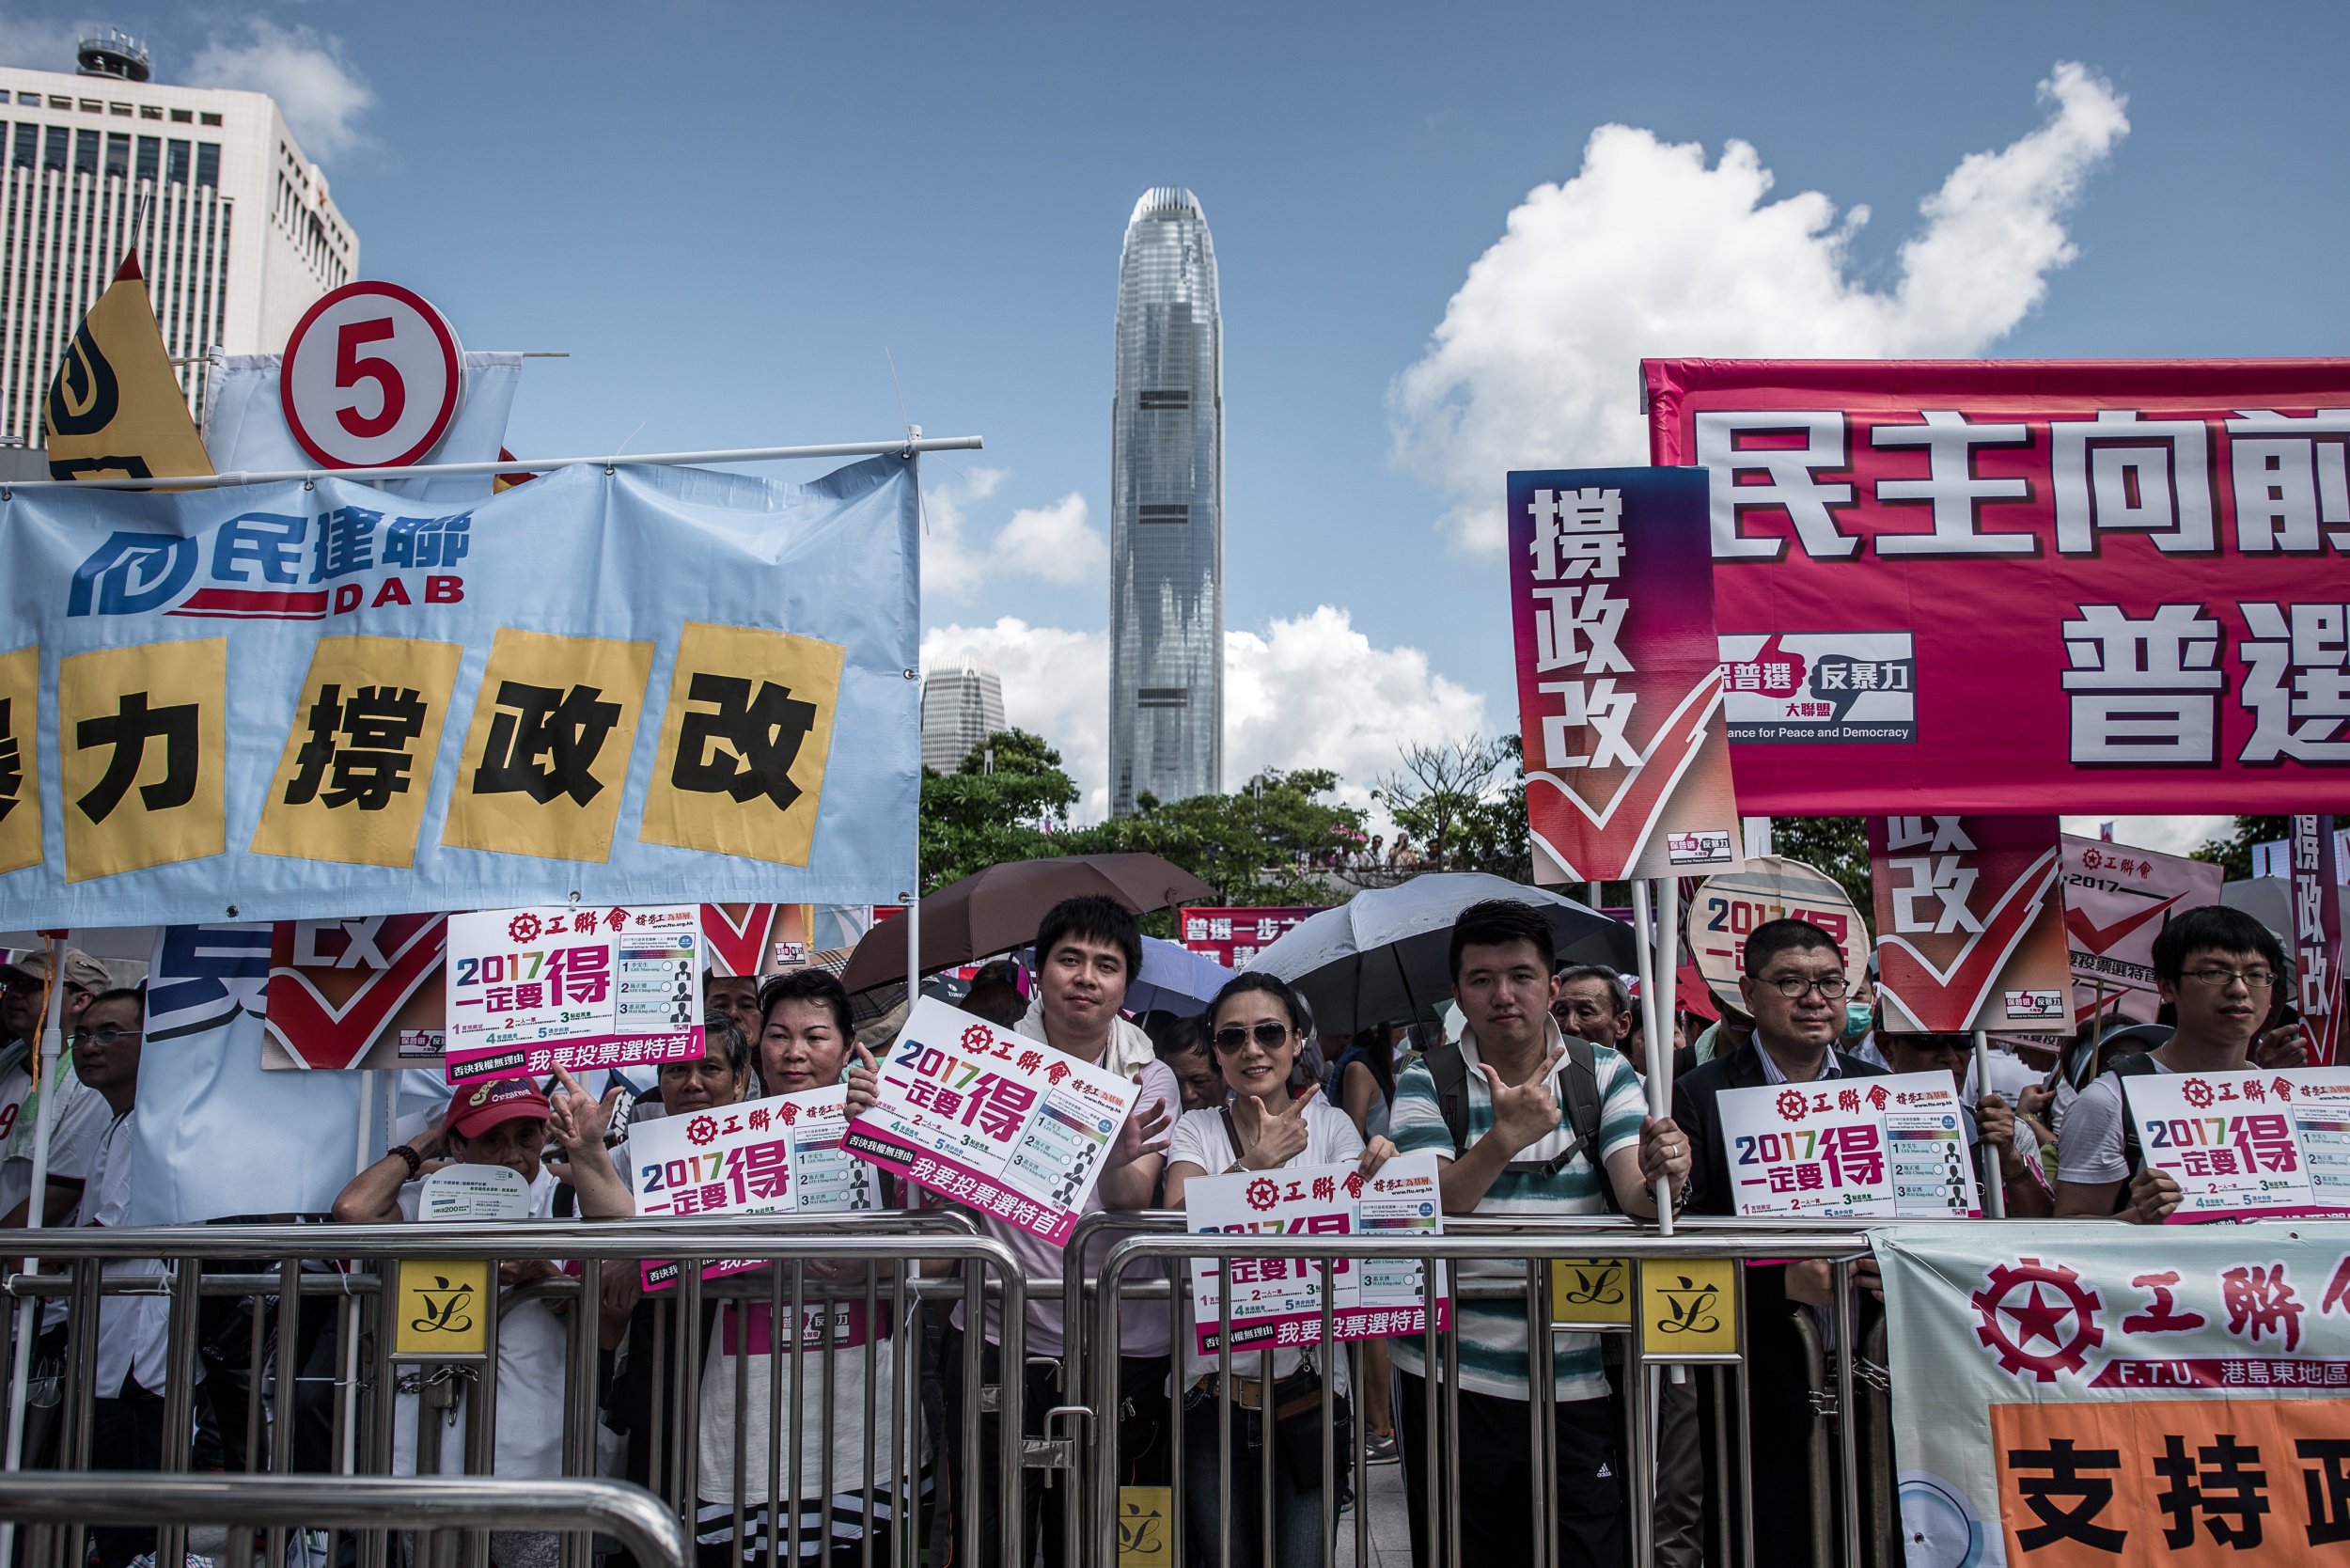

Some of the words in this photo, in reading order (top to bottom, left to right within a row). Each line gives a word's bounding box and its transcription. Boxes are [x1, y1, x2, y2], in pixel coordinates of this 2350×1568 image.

[334, 317, 406, 439] 5
[1694, 408, 2350, 557] 民主向前
[212, 506, 471, 585] 民建聯
[334, 575, 464, 616] DAB
[1528, 487, 1645, 769] 撐政改
[1821, 662, 1908, 690] 反暴力
[2061, 602, 2350, 763] 普選
[1785, 702, 1830, 717] 大聯盟
[1759, 728, 1775, 738] for
[1779, 728, 1813, 738] Peace
[1817, 728, 1840, 738] and
[1843, 727, 1909, 740] Democracy
[1702, 839, 1729, 849] 反暴力
[2104, 856, 2154, 879] 工聯會
[545, 906, 631, 936] 工聯會
[652, 921, 694, 930] www.ftu.org.hk
[457, 951, 543, 986] 2017
[622, 962, 629, 972] 1
[544, 945, 610, 1006] 得
[620, 982, 629, 993] 2
[455, 982, 542, 1012] 一定要
[619, 1003, 628, 1013] 3
[505, 1018, 514, 1029] 2
[560, 1011, 570, 1023] 3
[452, 1024, 460, 1034] 1
[538, 1027, 547, 1038] 5
[486, 1033, 496, 1043] 4
[454, 1053, 524, 1076] 否決我權無理由
[895, 1039, 980, 1090] 2017
[991, 1042, 1072, 1086] 工聯會
[492, 1089, 531, 1102] Original
[2217, 1075, 2295, 1105] 工聯會
[884, 1074, 964, 1121] 一定要
[1811, 1084, 1891, 1115] 工聯會
[961, 1072, 1038, 1142] 得
[1084, 1095, 1121, 1114] www.ftu.org.hk
[722, 1102, 802, 1136] 工聯會
[911, 1114, 923, 1125] 2
[1038, 1116, 1045, 1126] 1
[890, 1121, 901, 1132] 4
[2146, 1117, 2226, 1148] 2017
[934, 1137, 946, 1150] 5
[960, 1134, 971, 1146] 3
[1025, 1136, 1035, 1147] 2
[2228, 1114, 2297, 1174] 得
[2303, 1133, 2310, 1143] 1
[1734, 1130, 1816, 1166] 2017
[1892, 1142, 1900, 1153] 1
[799, 1154, 806, 1165] 1
[1013, 1154, 1024, 1166] 3
[1818, 1124, 1885, 1188] 得
[2155, 1148, 2239, 1177] 一定要
[2309, 1153, 2317, 1165] 2
[642, 1152, 724, 1194] 2017
[725, 1138, 791, 1204] 得
[1895, 1165, 1904, 1175] 2
[800, 1175, 808, 1185] 2
[1740, 1162, 1824, 1194] 一定要
[2313, 1175, 2322, 1185] 3
[848, 1135, 914, 1163] 否決我權無理由
[909, 1155, 1070, 1238] 我要投票選特首!
[1283, 1171, 1369, 1202] 工聯會
[1391, 1186, 1434, 1196] www.ftu.org.hk
[1897, 1186, 1905, 1197] 3
[2207, 1183, 2218, 1194] 2
[2259, 1180, 2269, 1191] 3
[645, 1182, 728, 1216] 一定要
[801, 1196, 809, 1205] 3
[1791, 1199, 1800, 1210] 2
[1842, 1193, 1852, 1205] 3
[2196, 1197, 2205, 1208] 4
[2243, 1194, 2252, 1206] 5
[1742, 1203, 1749, 1215] 1
[1364, 1276, 1372, 1286] 3
[1251, 1289, 1261, 1301] 2
[1306, 1284, 1315, 1295] 3
[1199, 1294, 1208, 1307] 1
[1285, 1299, 1294, 1310] 5
[2123, 1256, 2350, 1352] 工聯
[1234, 1305, 1245, 1316] 4
[814, 1314, 848, 1327] 反力
[2120, 1362, 2201, 1385] F.T.U.
[2221, 1360, 2350, 1385] 港島東地區
